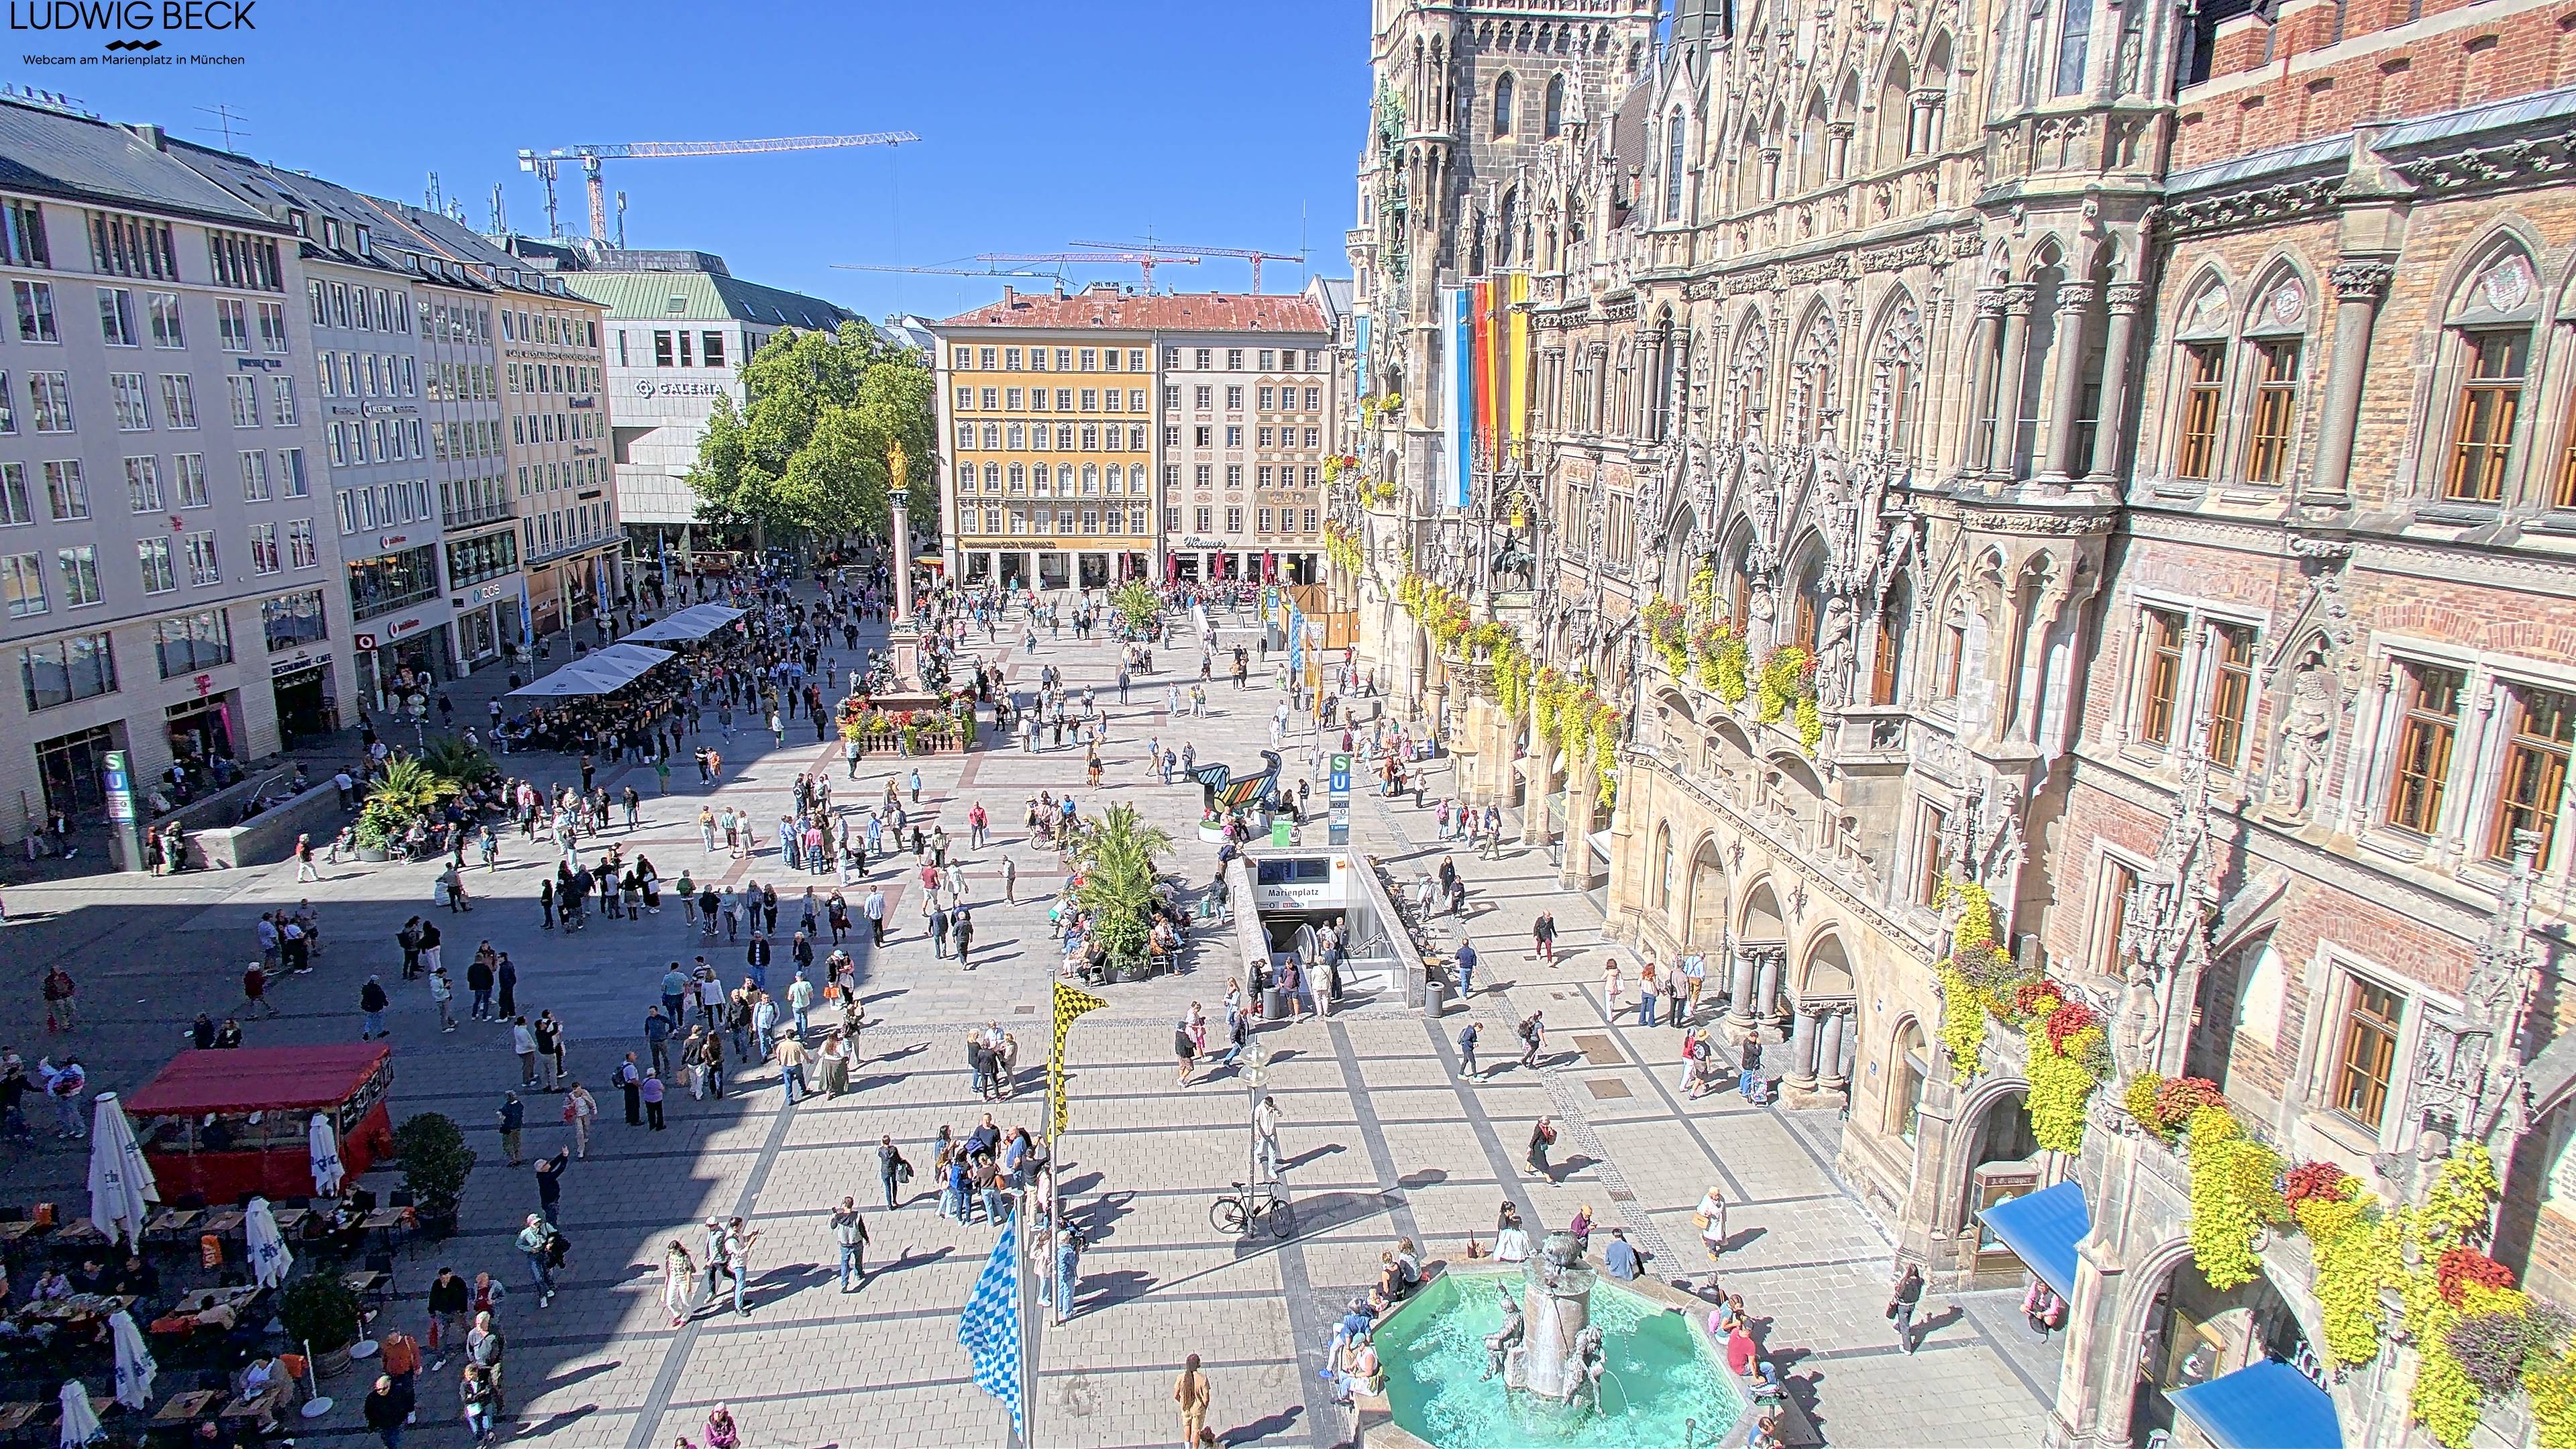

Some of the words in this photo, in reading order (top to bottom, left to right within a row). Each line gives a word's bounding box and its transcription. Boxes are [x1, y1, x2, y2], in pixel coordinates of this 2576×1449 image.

[659, 383, 723, 394] GALERIA
[372, 405, 394, 413] KERN
[481, 584, 500, 599] IQOS
[1269, 588, 1277, 596] S
[1269, 597, 1277, 607] U
[106, 754, 120, 769] S
[1334, 755, 1347, 771] S
[109, 773, 122, 789] U
[1333, 775, 1346, 790] U
[1267, 888, 1319, 898] Marienplatz
